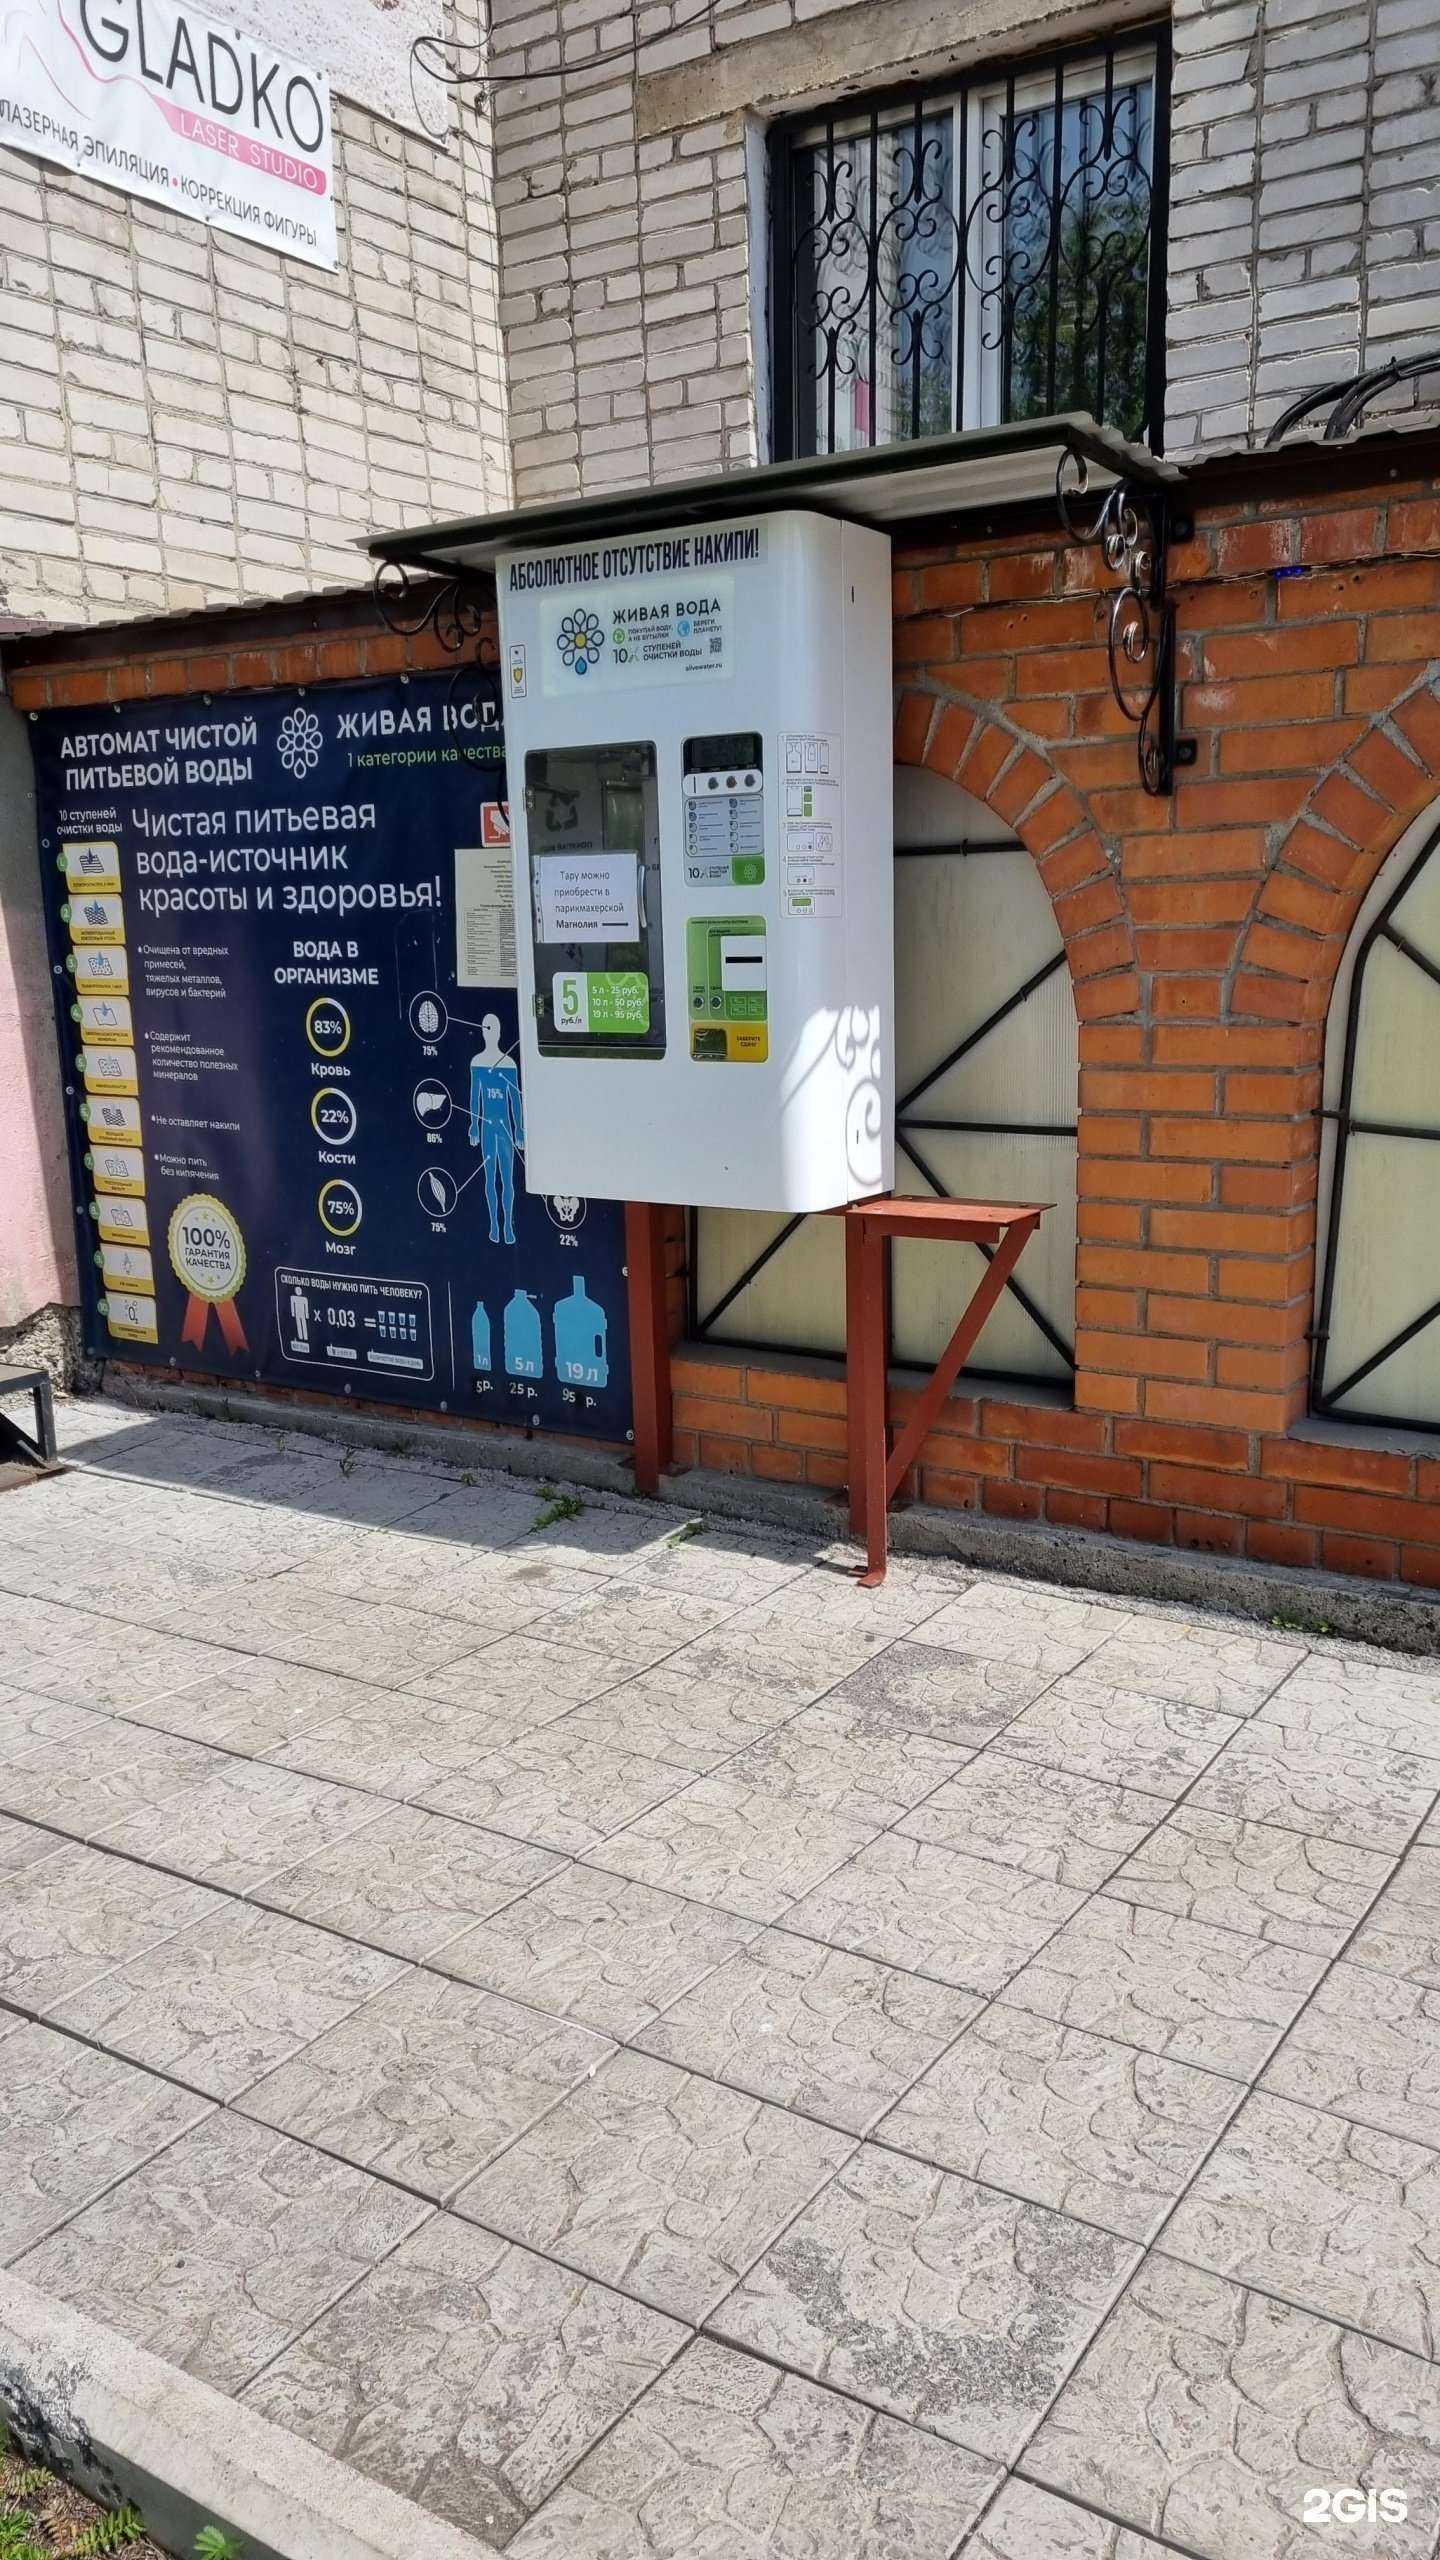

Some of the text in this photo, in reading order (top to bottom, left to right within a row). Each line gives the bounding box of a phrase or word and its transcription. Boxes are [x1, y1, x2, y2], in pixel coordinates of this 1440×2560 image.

[80, 0, 324, 153] GLADKO
[180, 112, 319, 191] LASER STUDIO
[0, 101, 318, 247] ЛАЗЕРНАЯ ЭПИЛЯЦИЯ КОРРЕКЦИЯ ФИГУРЫ
[509, 527, 760, 592] АБСОЛЮТНОЕ ОТСУТСТВИЕ НАКИПИ!
[612, 598, 721, 625] ЖИВАЯ ВОДА
[643, 640, 682, 653] СТУПЕНЕЙ
[643, 647, 703, 661] ОЧИСТКИ ВОДЫ
[612, 648, 628, 664] 10
[335, 700, 504, 739] ЖИВАЯ ВОД
[61, 716, 257, 759] АВТОМАТ ЧИСТОЙ
[347, 752, 353, 767] 1
[357, 749, 437, 769] категории
[66, 756, 253, 791] ПИТЬЕВОЙ ВОДЫ
[59, 807, 117, 823] 10 ступеней
[132, 803, 377, 838] Чистая питьевая
[57, 821, 123, 836] очистки воды
[136, 844, 349, 879] вода-источник
[559, 870, 610, 882] Тару можно
[139, 885, 248, 918] красоты
[256, 886, 273, 910] и
[282, 875, 443, 917] здоровья!
[554, 886, 610, 898] приобрести в
[555, 903, 624, 914] парикмахерской
[556, 919, 598, 929] Магнолия
[143, 944, 229, 957] Очищена от вредных
[292, 940, 359, 961] ВОДА В
[144, 959, 187, 971] примесей,
[145, 974, 223, 985] тяжелых металлов,
[273, 967, 380, 986] ОРГАНИЗМЕ
[146, 986, 227, 999] вирусов и бактерий
[562, 978, 579, 1016] 5
[313, 1019, 342, 1035] 83%
[150, 1030, 192, 1044] Содержит
[151, 1042, 225, 1057] рекомендованное
[152, 1057, 239, 1071] количество полезных
[311, 1062, 351, 1078] Кровь
[153, 1069, 198, 1082] минералов
[156, 1115, 241, 1132] Не оставляет накипи
[320, 1109, 349, 1124] 22%
[159, 1153, 208, 1167] Можно пить
[318, 1150, 357, 1165] Кости
[160, 1165, 220, 1181] без кипячения
[327, 1200, 355, 1215] 75%
[182, 1226, 231, 1249] 100%
[559, 1233, 579, 1247] 22%
[184, 1247, 230, 1260] ГАРАНТИЯ
[325, 1240, 356, 1256] Мозг
[186, 1257, 232, 1271] КАЧЕСТВА
[280, 1274, 423, 1300] СКОЛЬКО ВОДЫ НУЖНО ПИТЬ ЧЕЛОВЕКУ?
[327, 1307, 356, 1328] 0,03
[566, 1361, 599, 1382] 19 л
[509, 1381, 524, 1395] 25
[562, 1388, 576, 1403] 95
